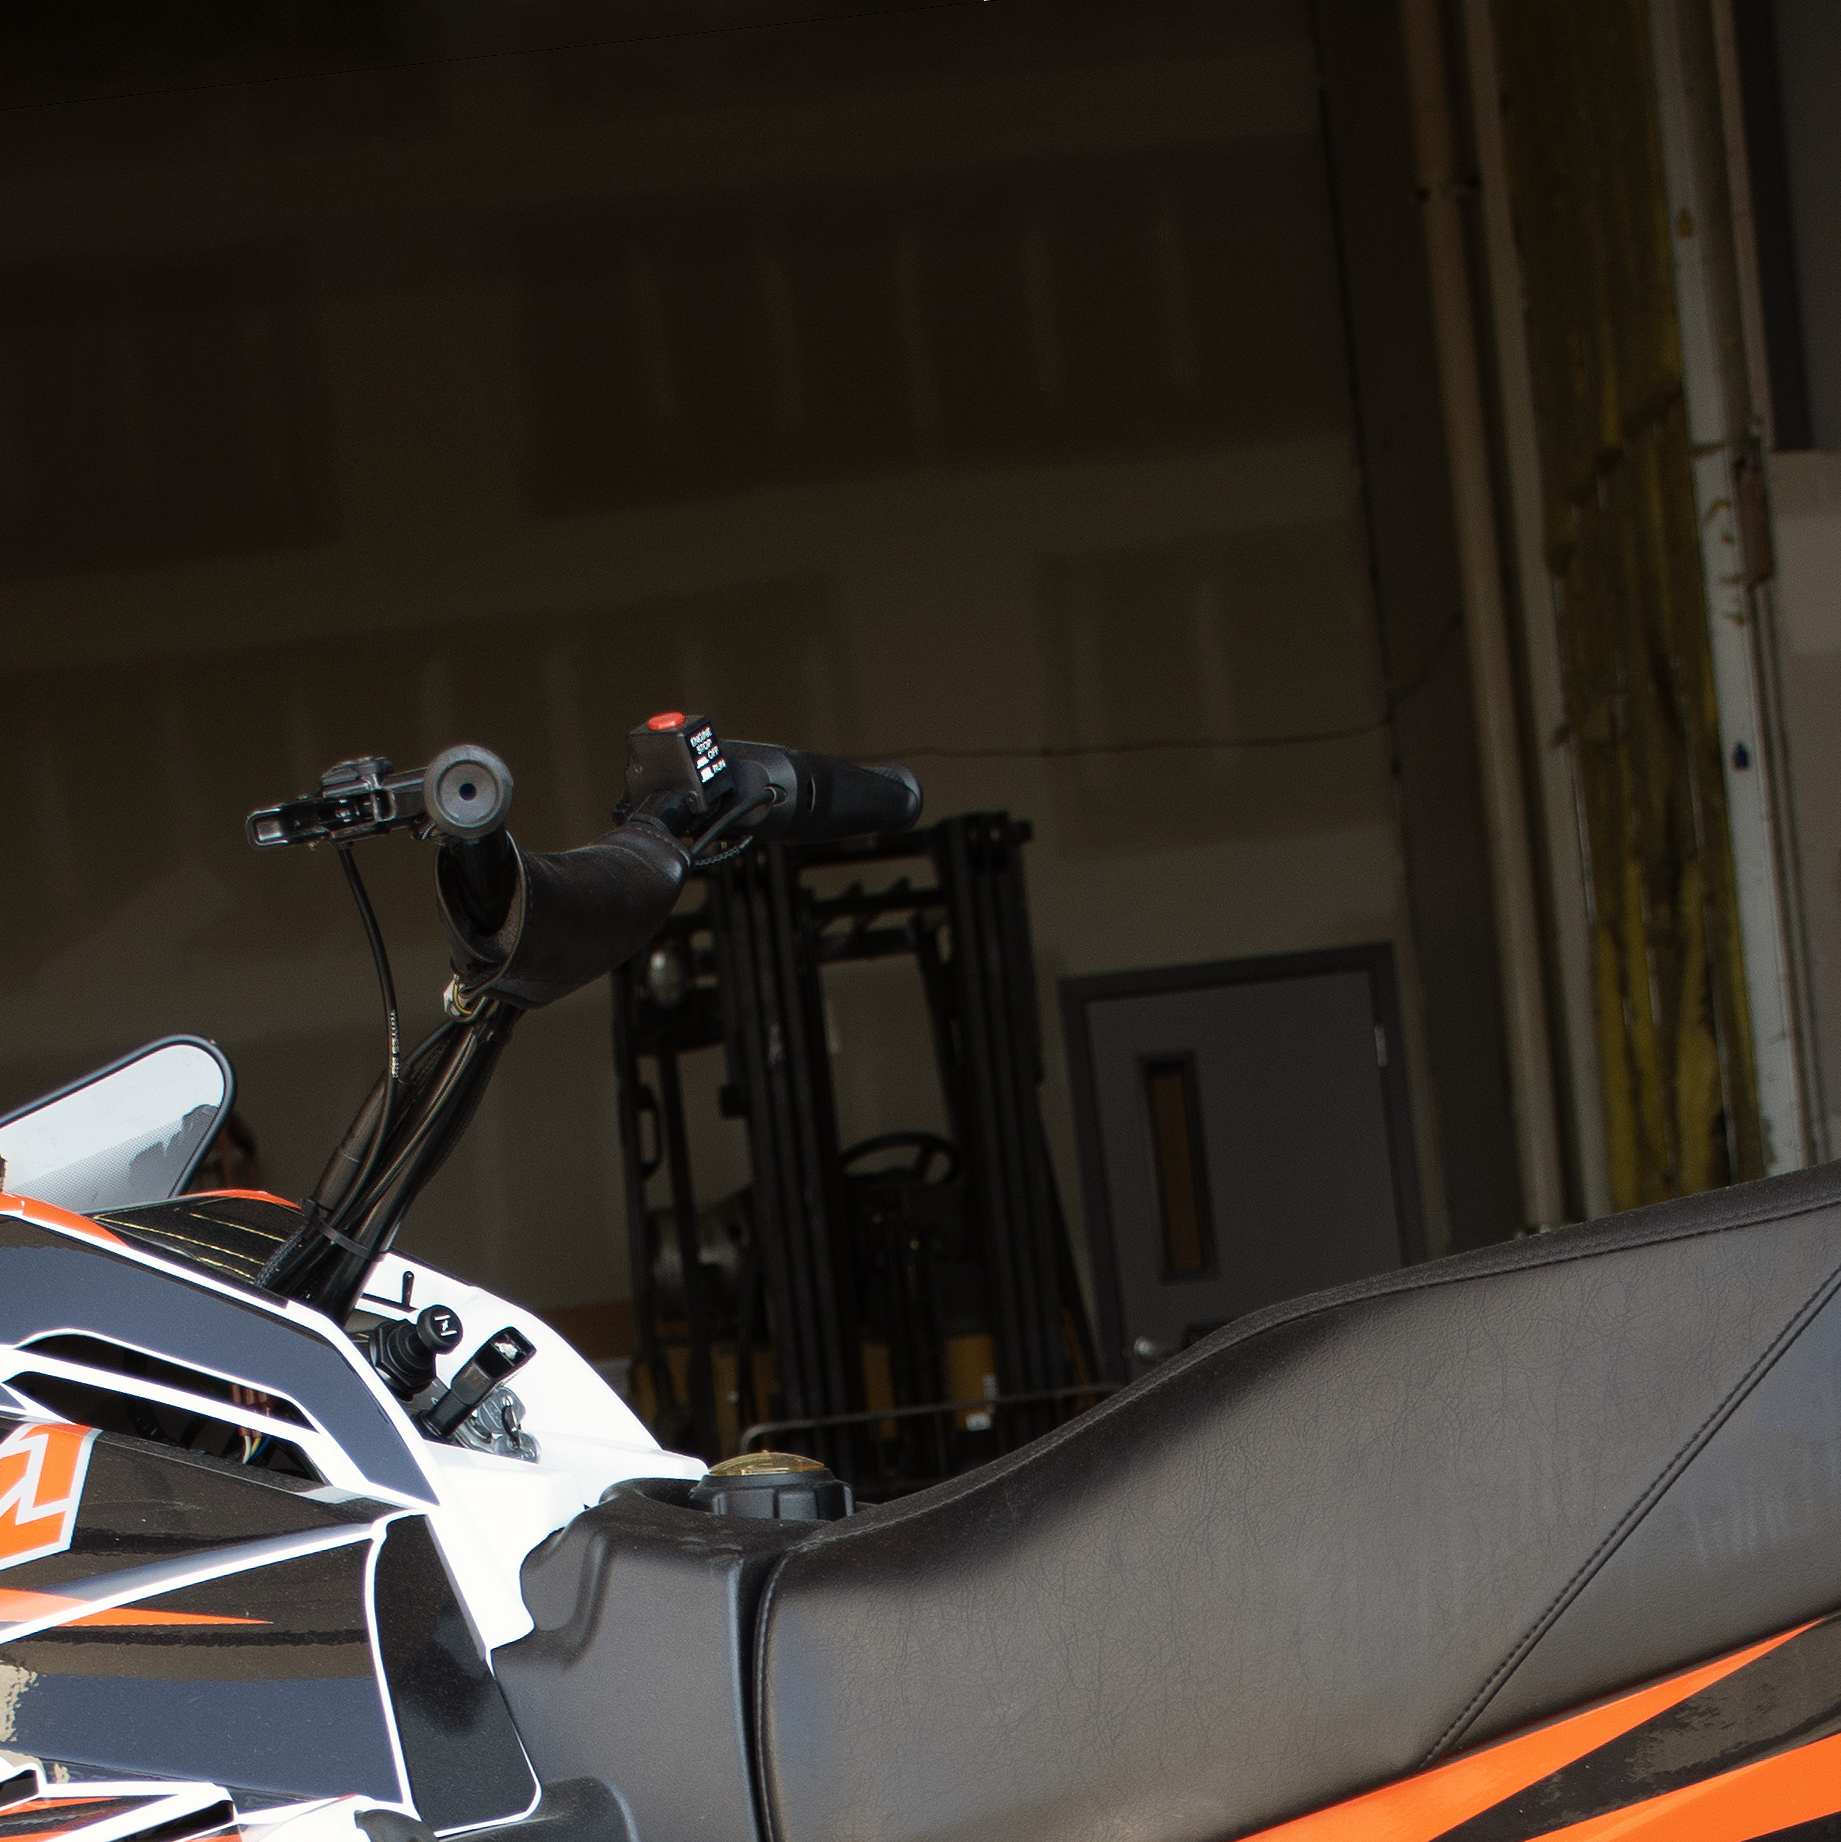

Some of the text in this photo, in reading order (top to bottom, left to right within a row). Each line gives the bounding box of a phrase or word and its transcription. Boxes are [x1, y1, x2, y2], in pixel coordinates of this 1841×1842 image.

[690, 727, 712, 747] ENGINE
[696, 739, 712, 754] STOP
[708, 746, 719, 759] OFF
